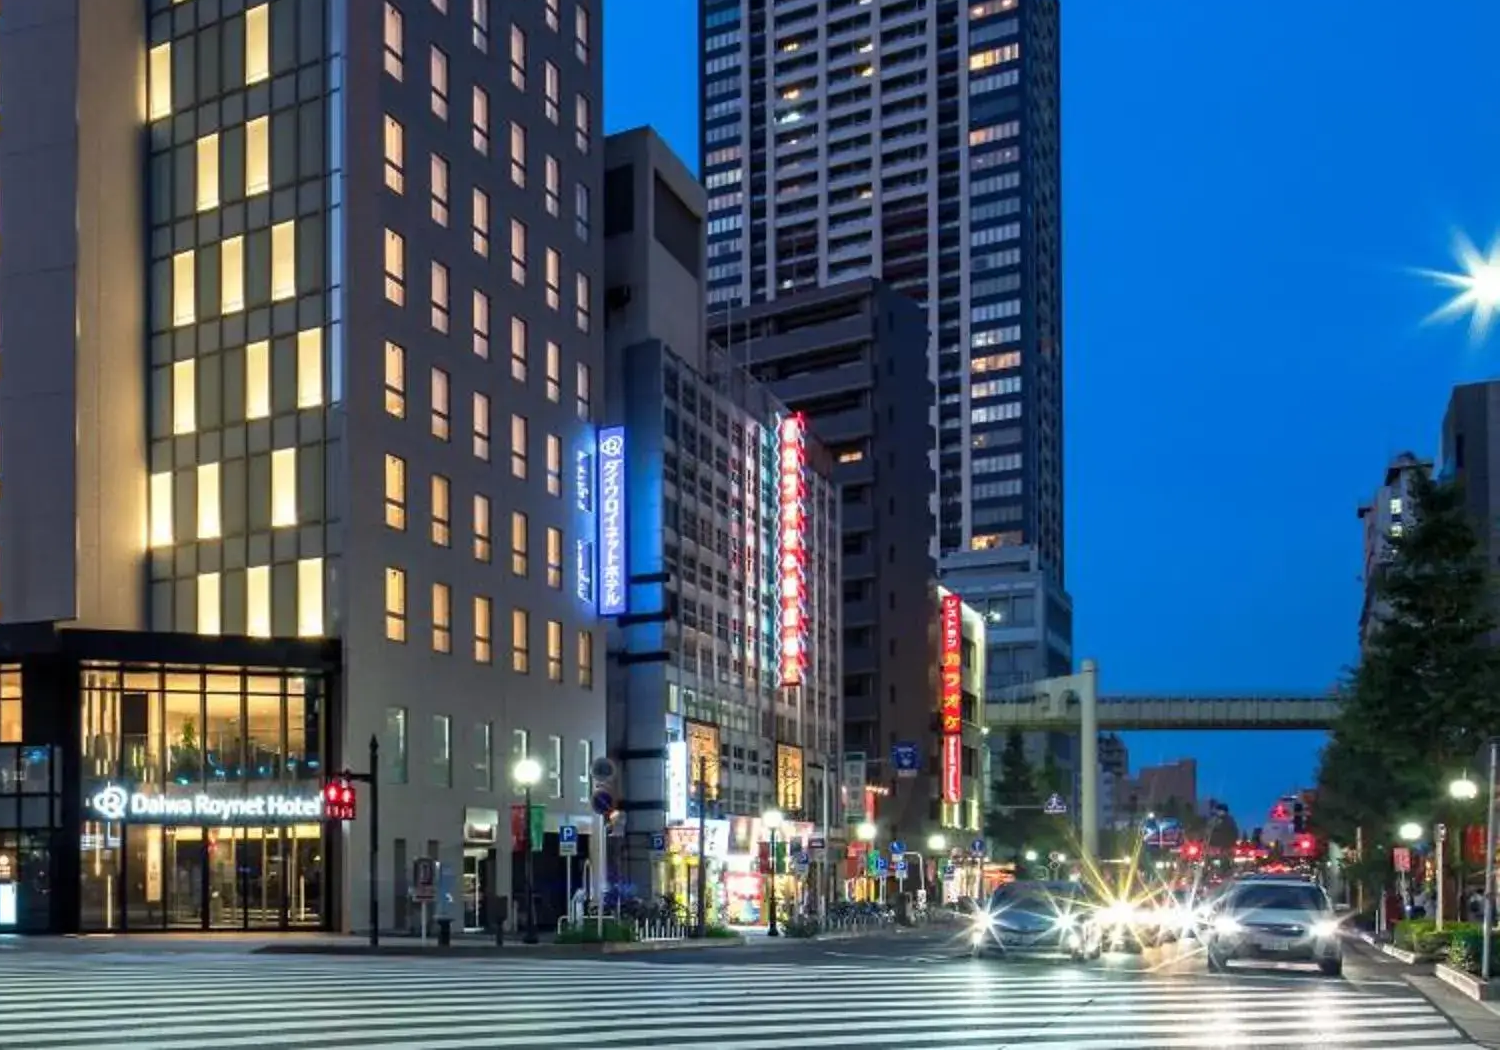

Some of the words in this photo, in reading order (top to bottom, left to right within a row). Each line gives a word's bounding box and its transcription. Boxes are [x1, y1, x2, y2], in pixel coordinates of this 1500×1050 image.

[603, 459, 624, 607] ダイワロイネットホテル
[131, 795, 193, 816] Daiwa
[195, 794, 266, 819] Roynet
[267, 790, 323, 816] Hotel
